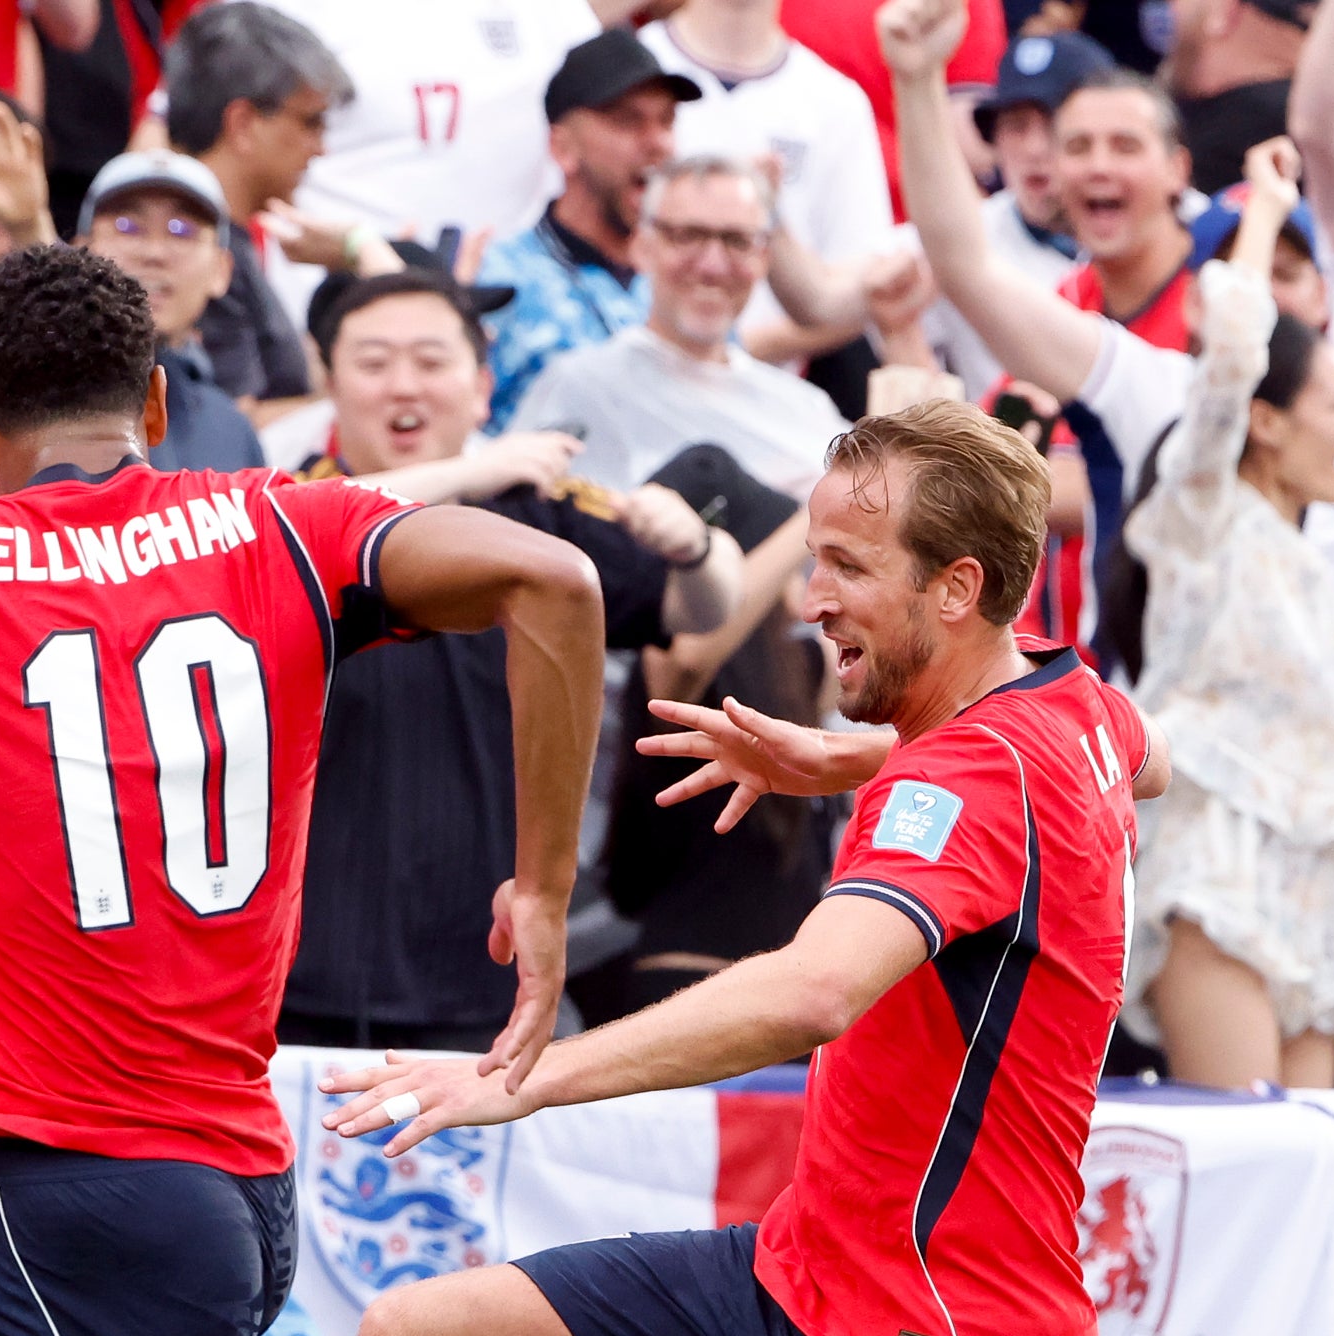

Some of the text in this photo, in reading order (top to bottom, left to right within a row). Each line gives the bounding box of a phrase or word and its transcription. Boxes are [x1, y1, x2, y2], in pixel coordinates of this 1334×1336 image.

[415, 84, 459, 141] 17
[21, 611, 274, 932] 10
[893, 820, 929, 841] PEACE
